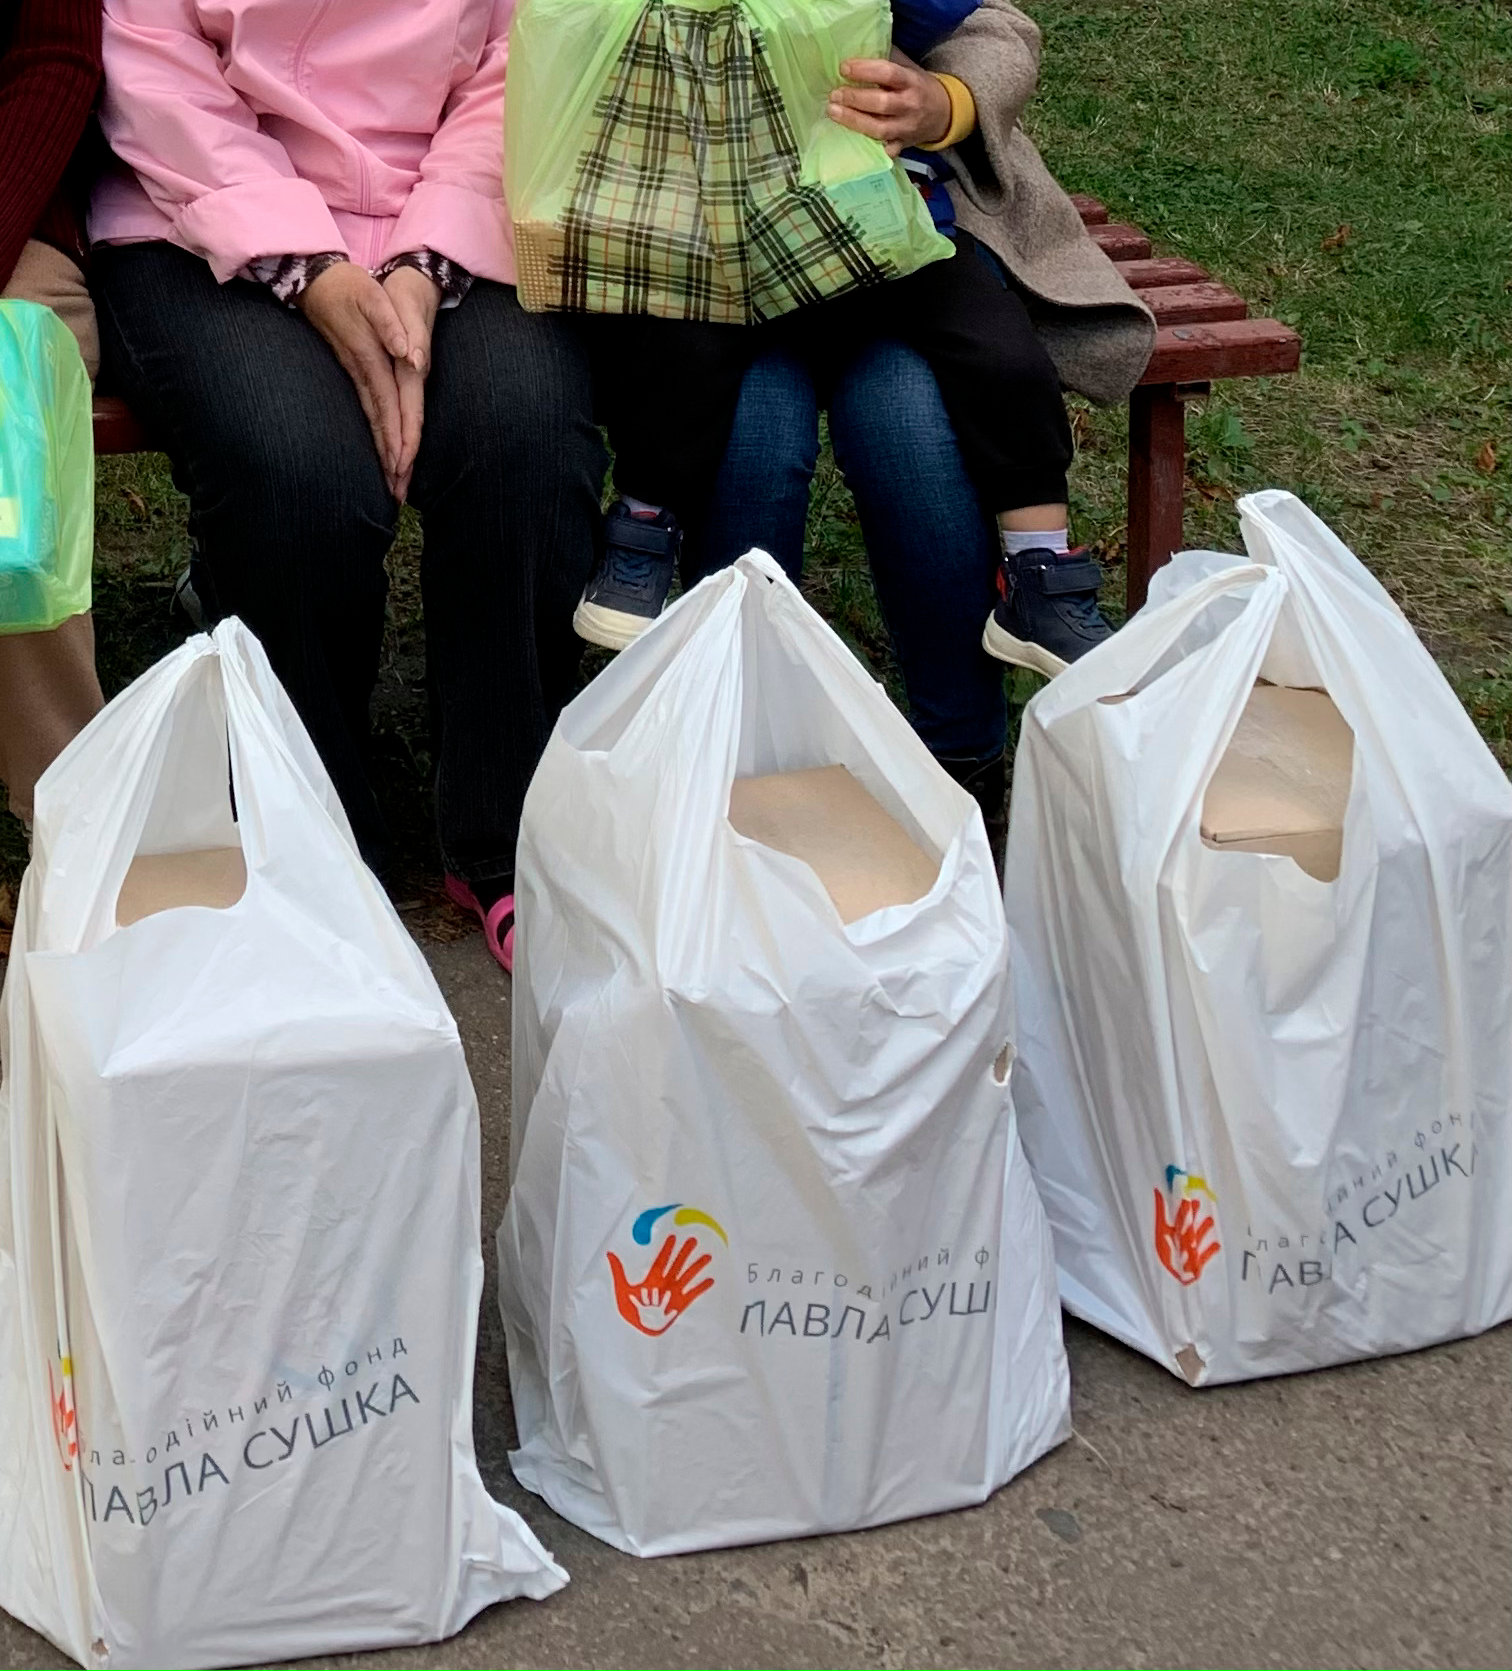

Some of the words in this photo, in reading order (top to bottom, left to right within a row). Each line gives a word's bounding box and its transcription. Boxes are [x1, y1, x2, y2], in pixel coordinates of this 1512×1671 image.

[739, 1300, 891, 1345] ПАВЛА
[899, 1280, 991, 1326] СУШ
[317, 1336, 409, 1392] фонд
[242, 1372, 421, 1471] СУШКА
